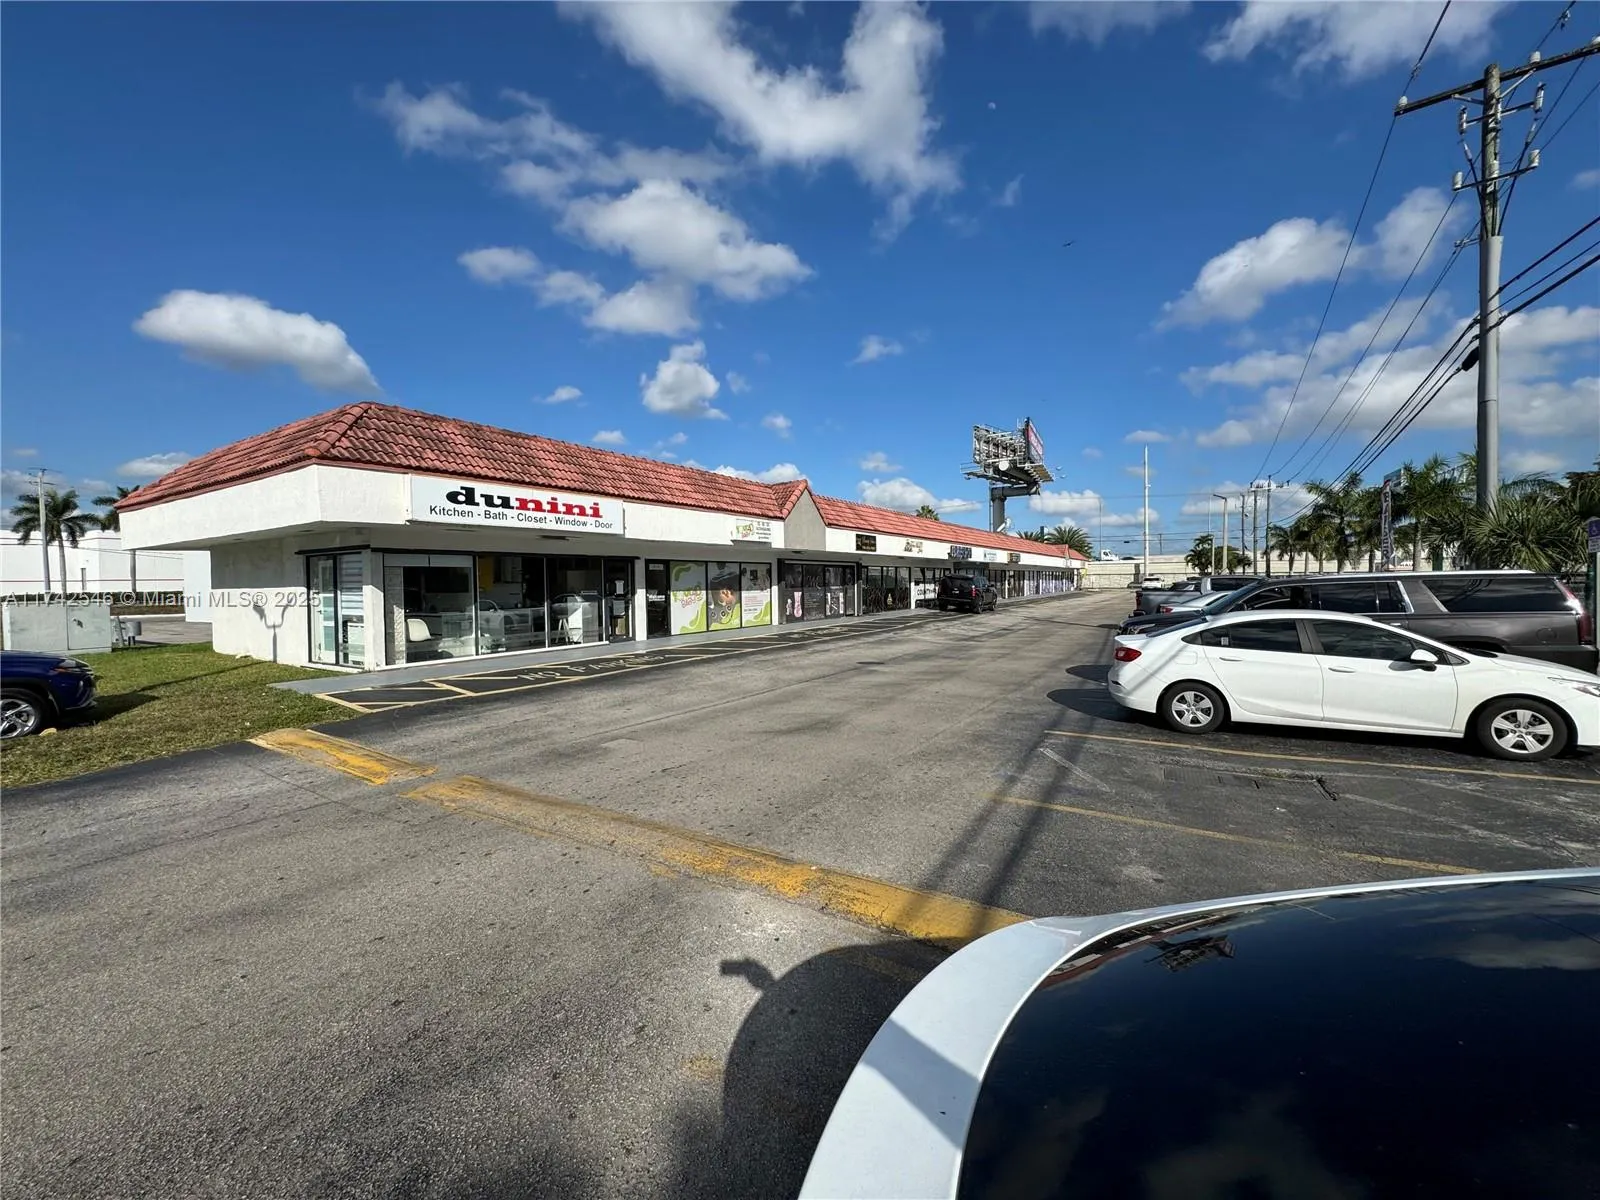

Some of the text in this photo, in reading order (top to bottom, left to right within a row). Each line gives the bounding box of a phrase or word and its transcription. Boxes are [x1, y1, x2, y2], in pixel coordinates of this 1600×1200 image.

[446, 486, 603, 518] dunini
[429, 505, 474, 518] Kitchen
[484, 510, 508, 520] Bath
[517, 513, 547, 524] Closet
[555, 517, 588, 527] Window
[595, 520, 613, 529] Door
